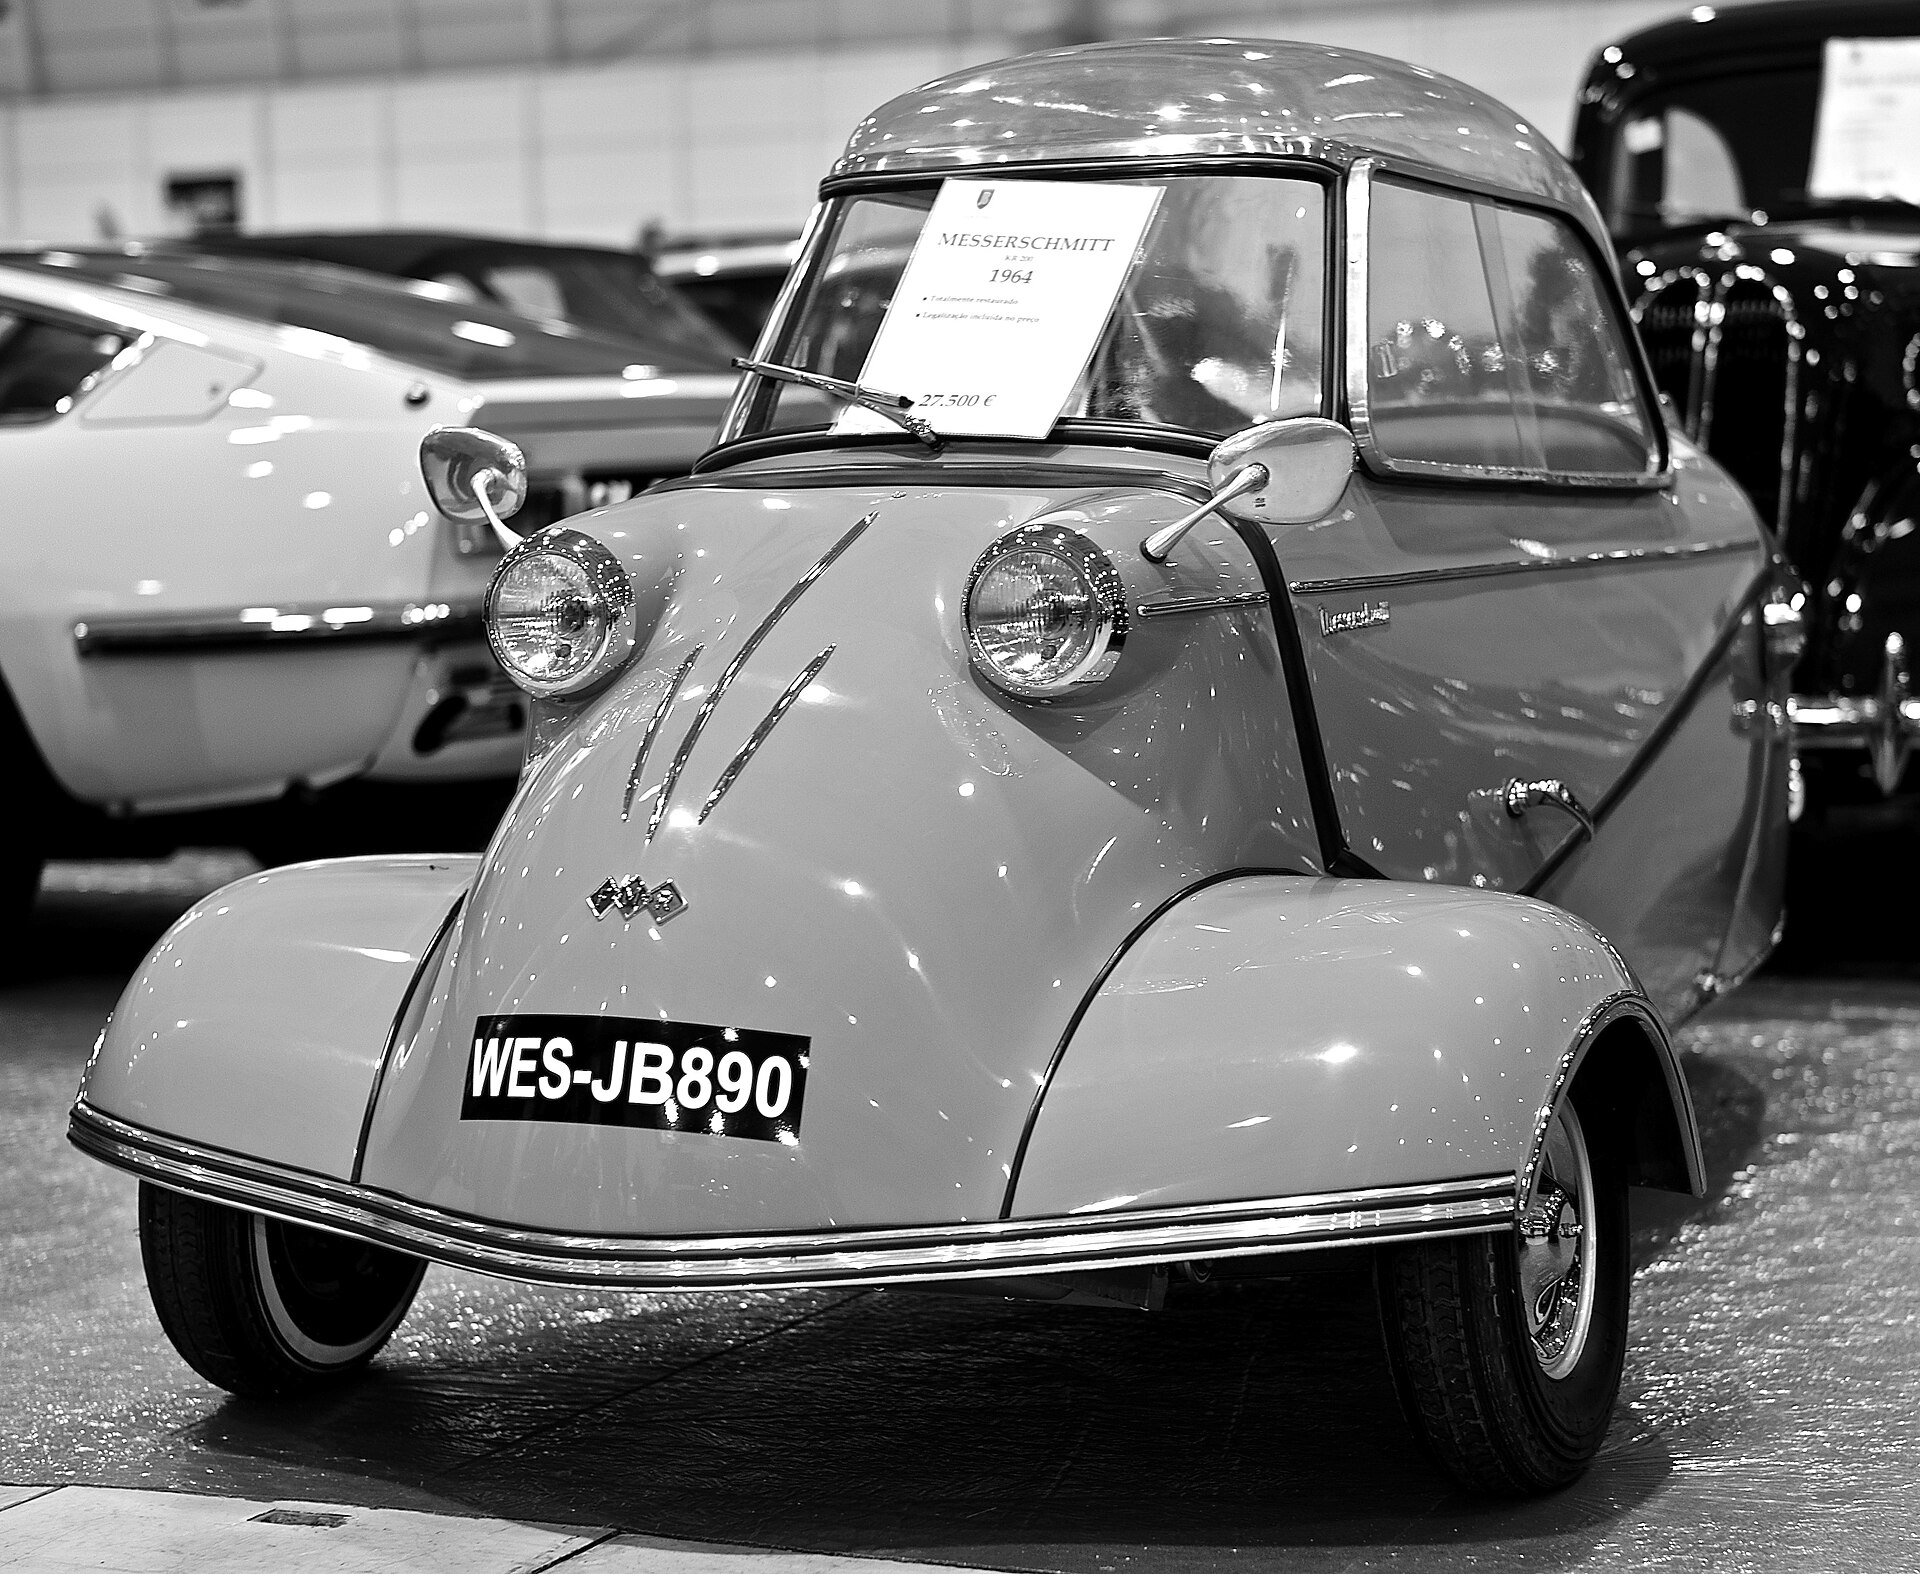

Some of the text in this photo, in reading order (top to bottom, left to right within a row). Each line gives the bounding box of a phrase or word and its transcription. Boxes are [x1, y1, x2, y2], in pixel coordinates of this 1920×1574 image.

[938, 233, 1115, 251] MESSERSCHMITT
[989, 269, 1034, 284] 1964
[918, 394, 997, 407] 27.500 €
[472, 1036, 793, 1119] WES-JB890
